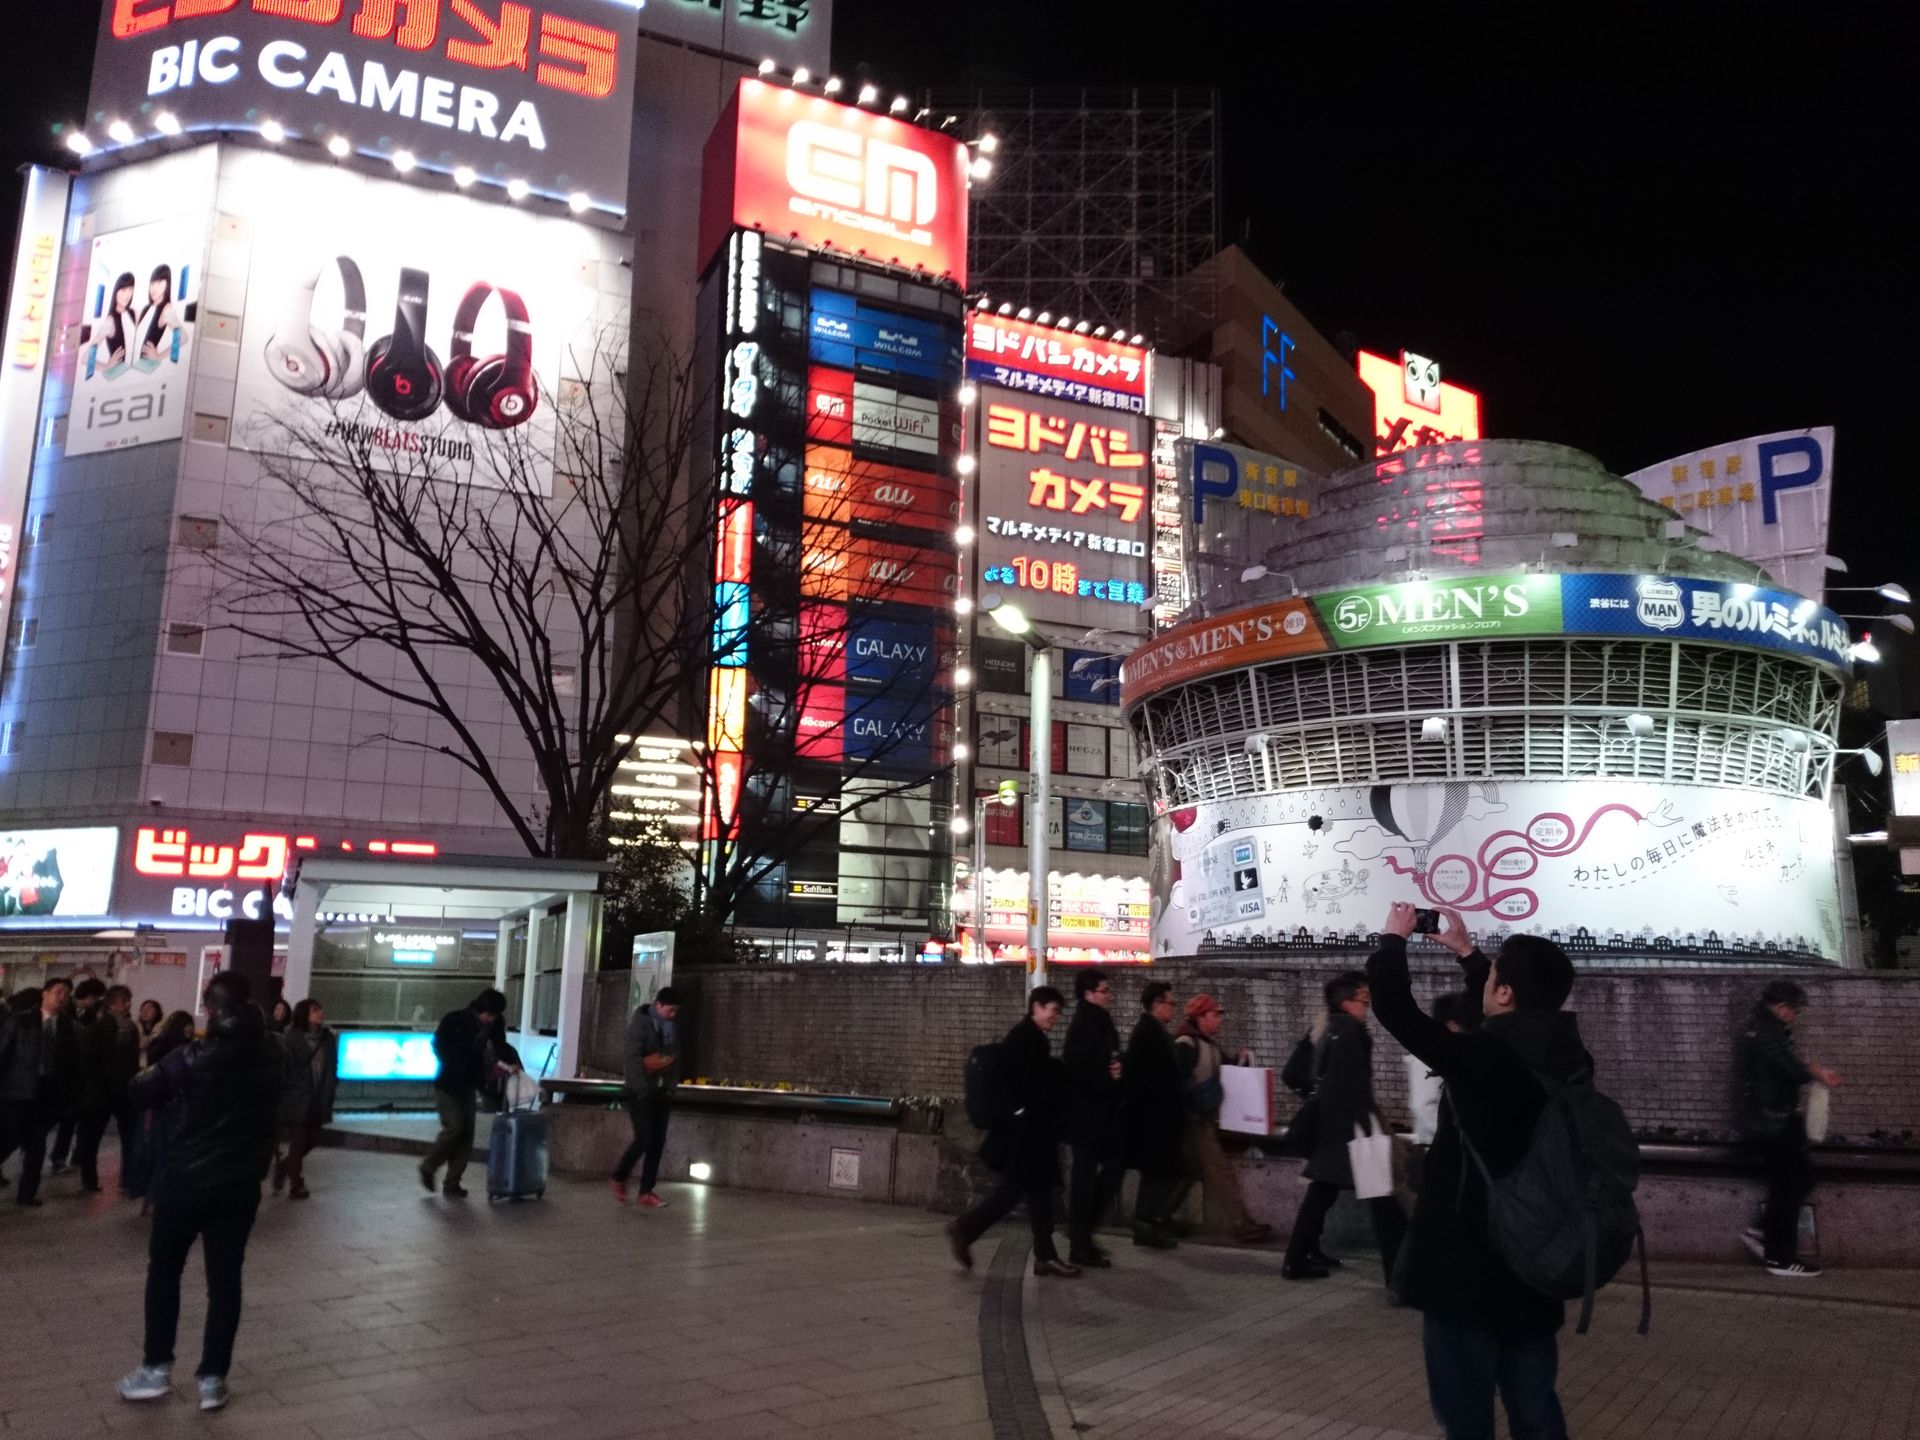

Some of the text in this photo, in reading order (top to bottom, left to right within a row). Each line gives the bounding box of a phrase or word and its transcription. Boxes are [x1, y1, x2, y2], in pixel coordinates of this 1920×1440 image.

[147, 36, 546, 150] BIC CAMERA
[972, 322, 1141, 382] ヨドバシカメラ
[86, 383, 167, 430] isai
[988, 403, 1145, 467] ヨドバシ
[809, 474, 846, 491] au
[1194, 443, 1238, 525] P
[1757, 436, 1824, 525] P
[874, 485, 916, 505] au
[1029, 468, 1145, 522] カメラ
[986, 515, 1146, 558] マルチメディア新宿東口
[868, 558, 916, 583] au
[984, 556, 1146, 604] よる10時まで営業
[1339, 584, 1529, 630] 5F MEN'S
[1589, 597, 1630, 610] 渋谷には
[1643, 602, 1678, 619] MAN
[856, 637, 927, 662] GALAXY
[985, 659, 1016, 668] HITACHI
[1124, 642, 1174, 688] OMEN'S
[853, 718, 925, 741] GALAXY
[1069, 745, 1103, 756] REGZA
[1069, 829, 1104, 843] raycop
[1574, 807, 1781, 882] わたしの毎日に魔法をかけて。
[1743, 838, 1776, 861] ルミネ
[171, 887, 234, 918] BIC
[803, 886, 833, 894] SoftBank
[1050, 900, 1062, 912] 4F
[1239, 902, 1261, 915] VISA
[1050, 916, 1062, 928] 3F
